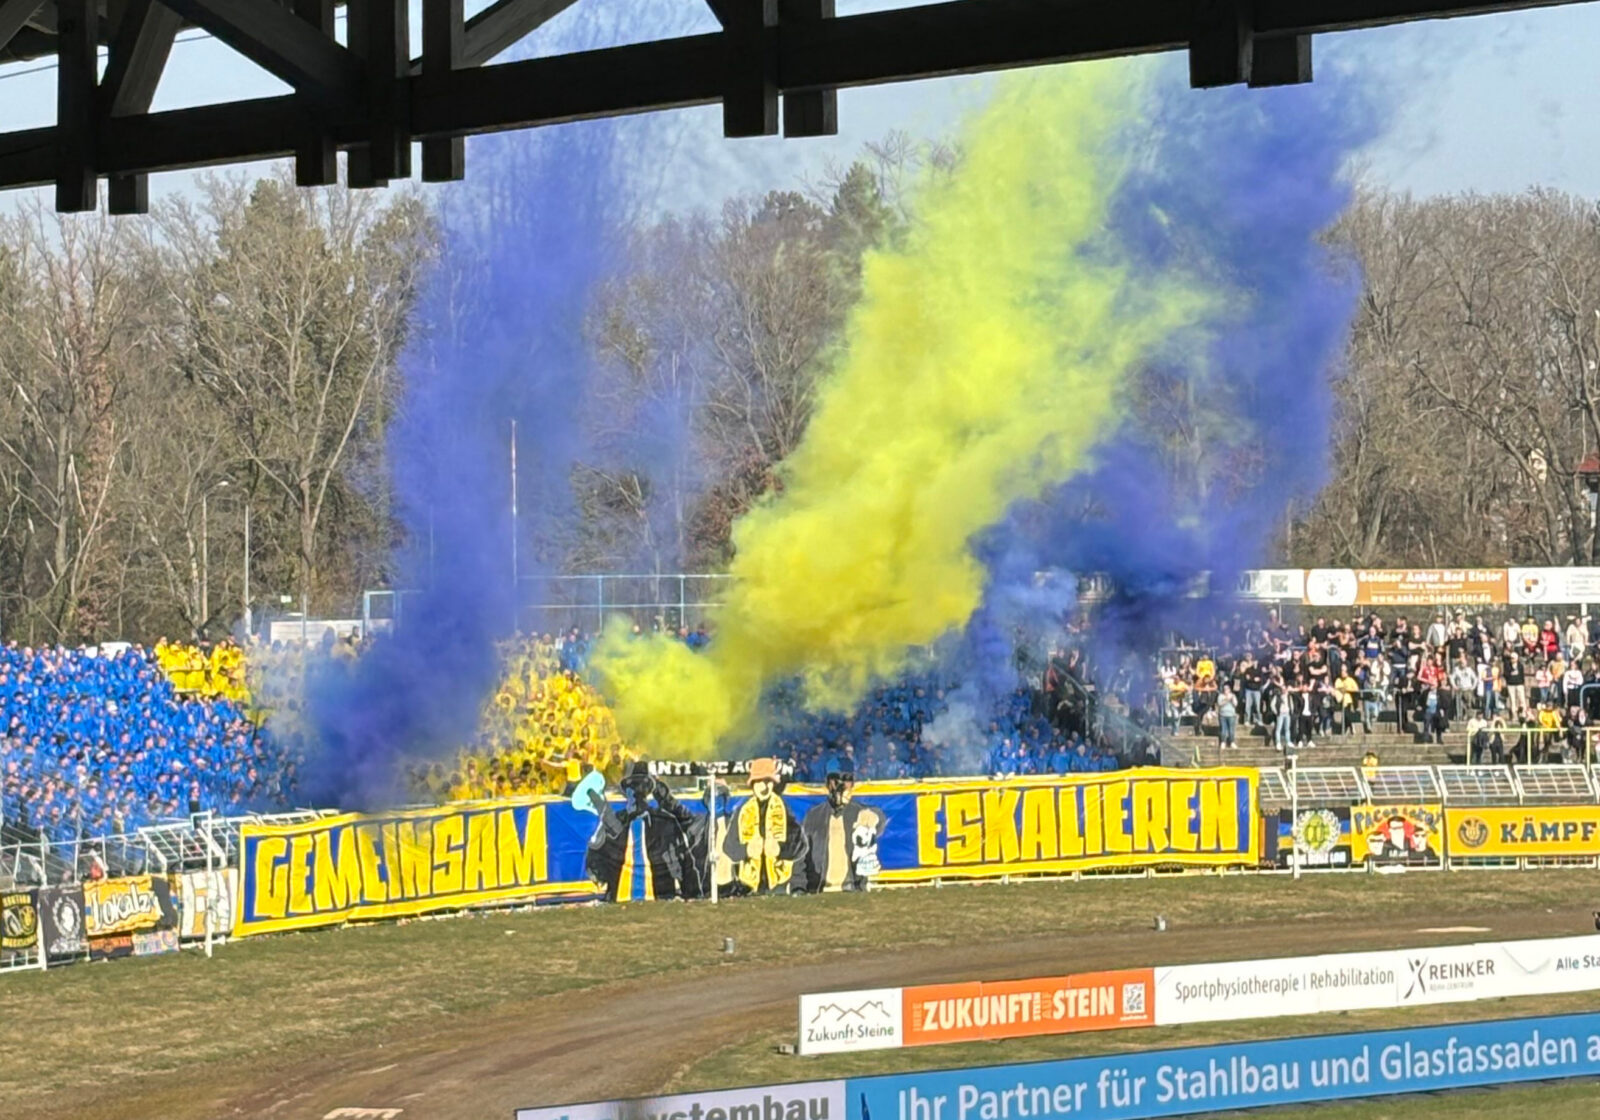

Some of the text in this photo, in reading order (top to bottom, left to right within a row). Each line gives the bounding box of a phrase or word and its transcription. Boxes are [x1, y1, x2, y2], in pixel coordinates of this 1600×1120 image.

[1405, 571, 1439, 582] Anker
[1443, 570, 1466, 582] Bad
[916, 779, 1239, 866] ESKALIEREN
[1500, 817, 1597, 843] KÄMPF
[253, 804, 549, 918] GEMEINSAM
[1429, 959, 1495, 980] REINKER
[1556, 957, 1580, 971] Alle
[1175, 972, 1300, 1002] Sportphysiotherapie
[1310, 966, 1395, 990] Rehabilitation
[922, 994, 1034, 1032] ZUKUNFT
[1053, 986, 1115, 1020] STEIN
[899, 1087, 946, 1120] Ihr
[958, 1079, 1088, 1120] Partner
[1097, 1069, 1147, 1109] für
[1155, 1055, 1299, 1103] Stahlbau
[1310, 1045, 1370, 1088] und
[1379, 1029, 1577, 1081] Glasfassaden
